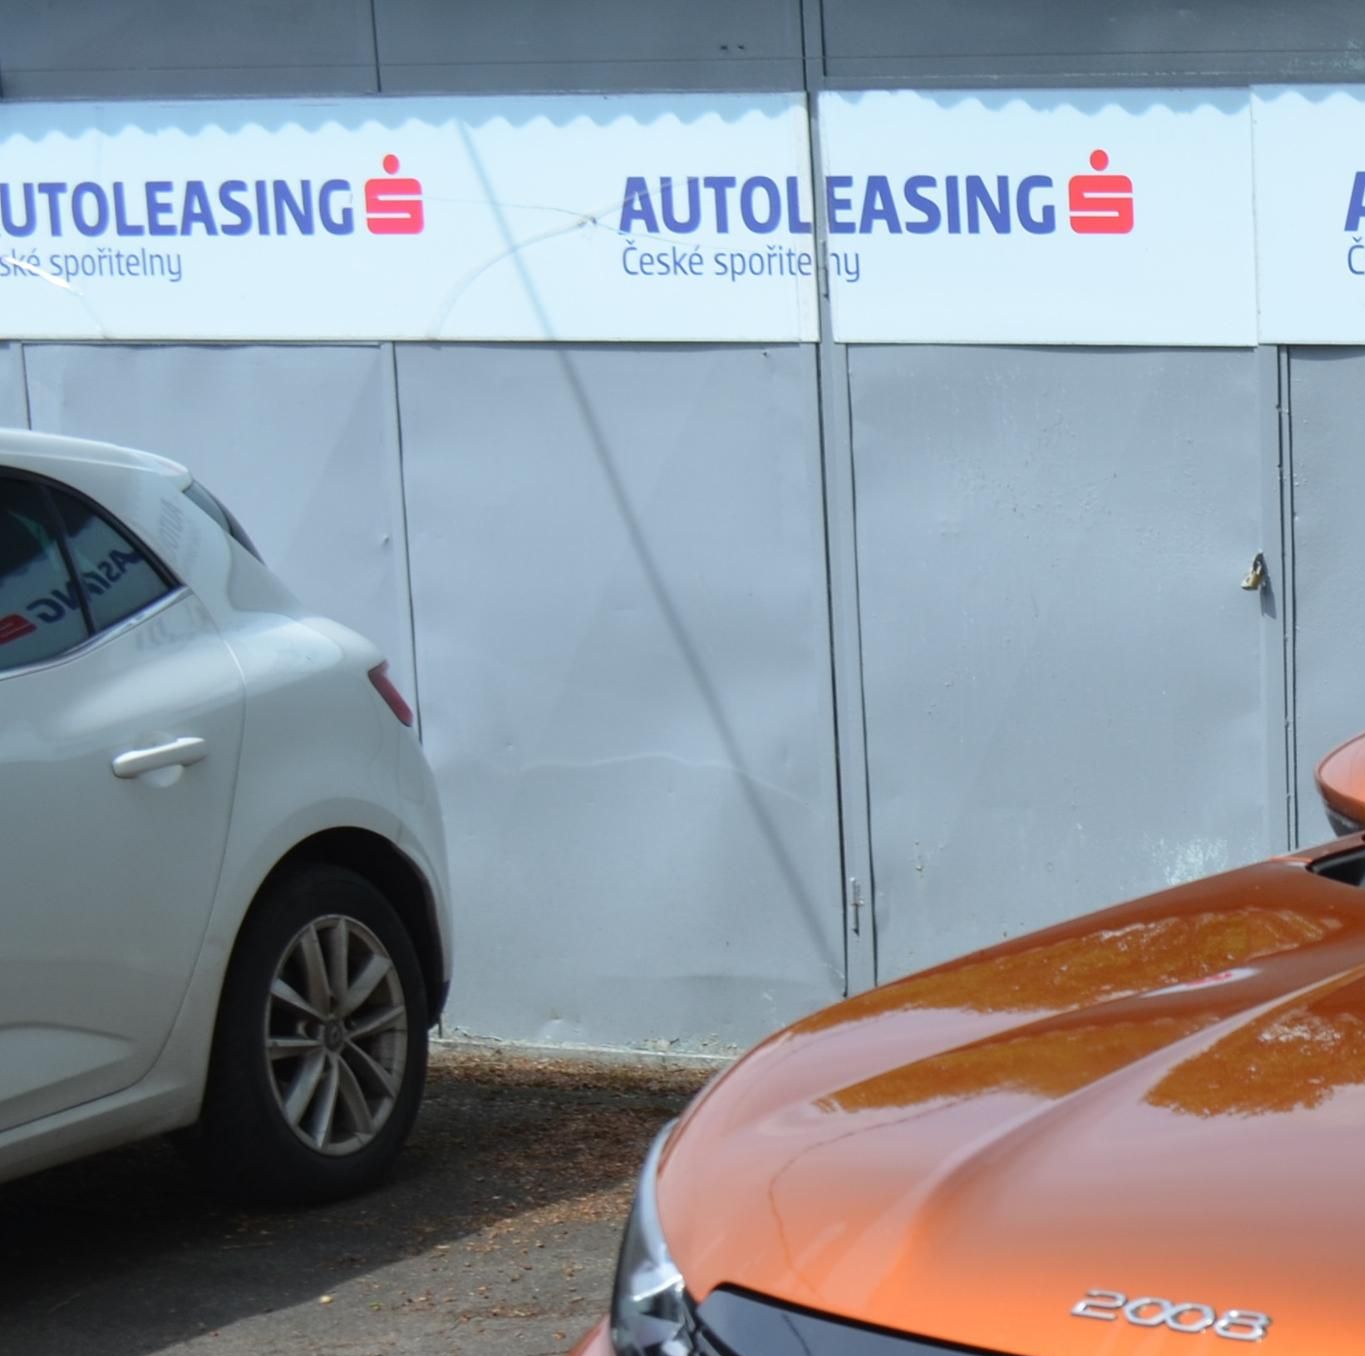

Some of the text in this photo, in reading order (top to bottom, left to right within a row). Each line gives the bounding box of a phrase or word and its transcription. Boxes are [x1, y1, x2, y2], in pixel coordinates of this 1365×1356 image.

[0, 180, 354, 238] UTOLEASING
[619, 174, 1056, 235] AUTOLEASING
[49, 247, 183, 283] spořitelny
[622, 239, 861, 283] České spořiteny
[1071, 1288, 1271, 1342] 2008
